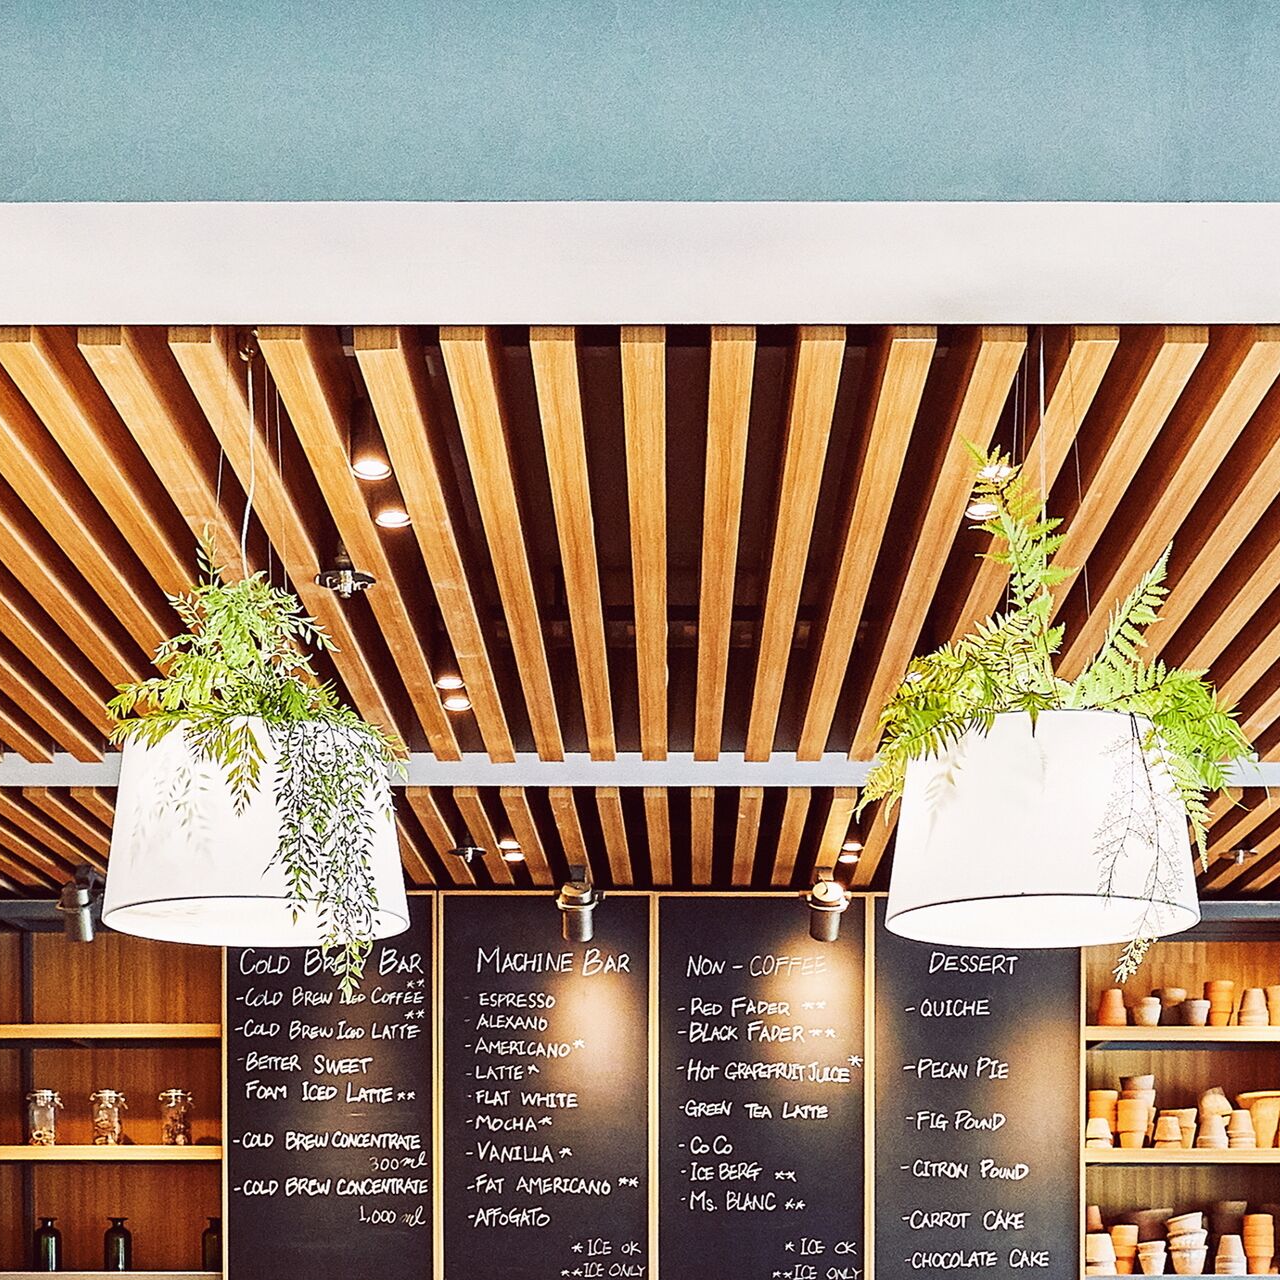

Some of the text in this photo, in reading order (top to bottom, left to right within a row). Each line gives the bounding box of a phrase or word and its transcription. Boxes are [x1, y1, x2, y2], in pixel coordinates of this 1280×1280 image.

[240, 948, 290, 975] COLD
[379, 947, 424, 976] BAR
[477, 945, 630, 976] MACHINE BAR
[687, 955, 726, 977] NON
[750, 956, 827, 977] COFFEE
[929, 949, 1018, 974] DESSERT
[245, 988, 283, 1007] COLD
[292, 986, 333, 1006] BREW
[368, 985, 424, 1005] COFFEE
[479, 993, 555, 1008] ESPRESSO
[691, 997, 790, 1020] RED FADER
[920, 999, 990, 1017] QUICHE
[244, 1019, 280, 1037] COLD
[289, 1020, 334, 1040] BREW
[369, 1023, 421, 1042] LATTE
[476, 1011, 548, 1034] ALEXANO
[689, 1018, 803, 1043] BLACK FADER
[475, 1035, 570, 1060] AMERICANO
[246, 1051, 373, 1077] BETTER SWEET
[476, 1063, 527, 1080] LATTE
[724, 1061, 808, 1082] GRAPEFRUIT
[805, 1062, 853, 1083] JUICE
[918, 1057, 1009, 1079] PECAN PIE
[246, 1078, 393, 1103] FOAM ICED LATTE
[475, 1090, 578, 1111] FLAT WHITE
[685, 1100, 828, 1119] GREEN TEA LATTE
[475, 1113, 540, 1132] MOCHA
[917, 1110, 1006, 1131] FIG POUND
[242, 1131, 421, 1151] COLD BREW CONCENTRATE
[477, 1141, 554, 1163] VANILLA
[690, 1162, 763, 1181] ICE BERG
[913, 1159, 1029, 1180] CITRON POUND
[243, 1177, 428, 1196] COLD BREW CONCENTRATE
[476, 1174, 611, 1195] FAT AMERICANO
[726, 1190, 776, 1211] BLANC
[474, 1207, 550, 1227] AFFOGATO
[907, 1209, 1024, 1231] CARROT CAKE
[587, 1238, 641, 1256] ICE OK
[800, 1238, 857, 1255] ICE OK
[583, 1261, 646, 1277] ICE ONLY
[912, 1249, 1049, 1269] CHOCOLATE CAKE
[793, 1264, 862, 1280] ICE ONLY
